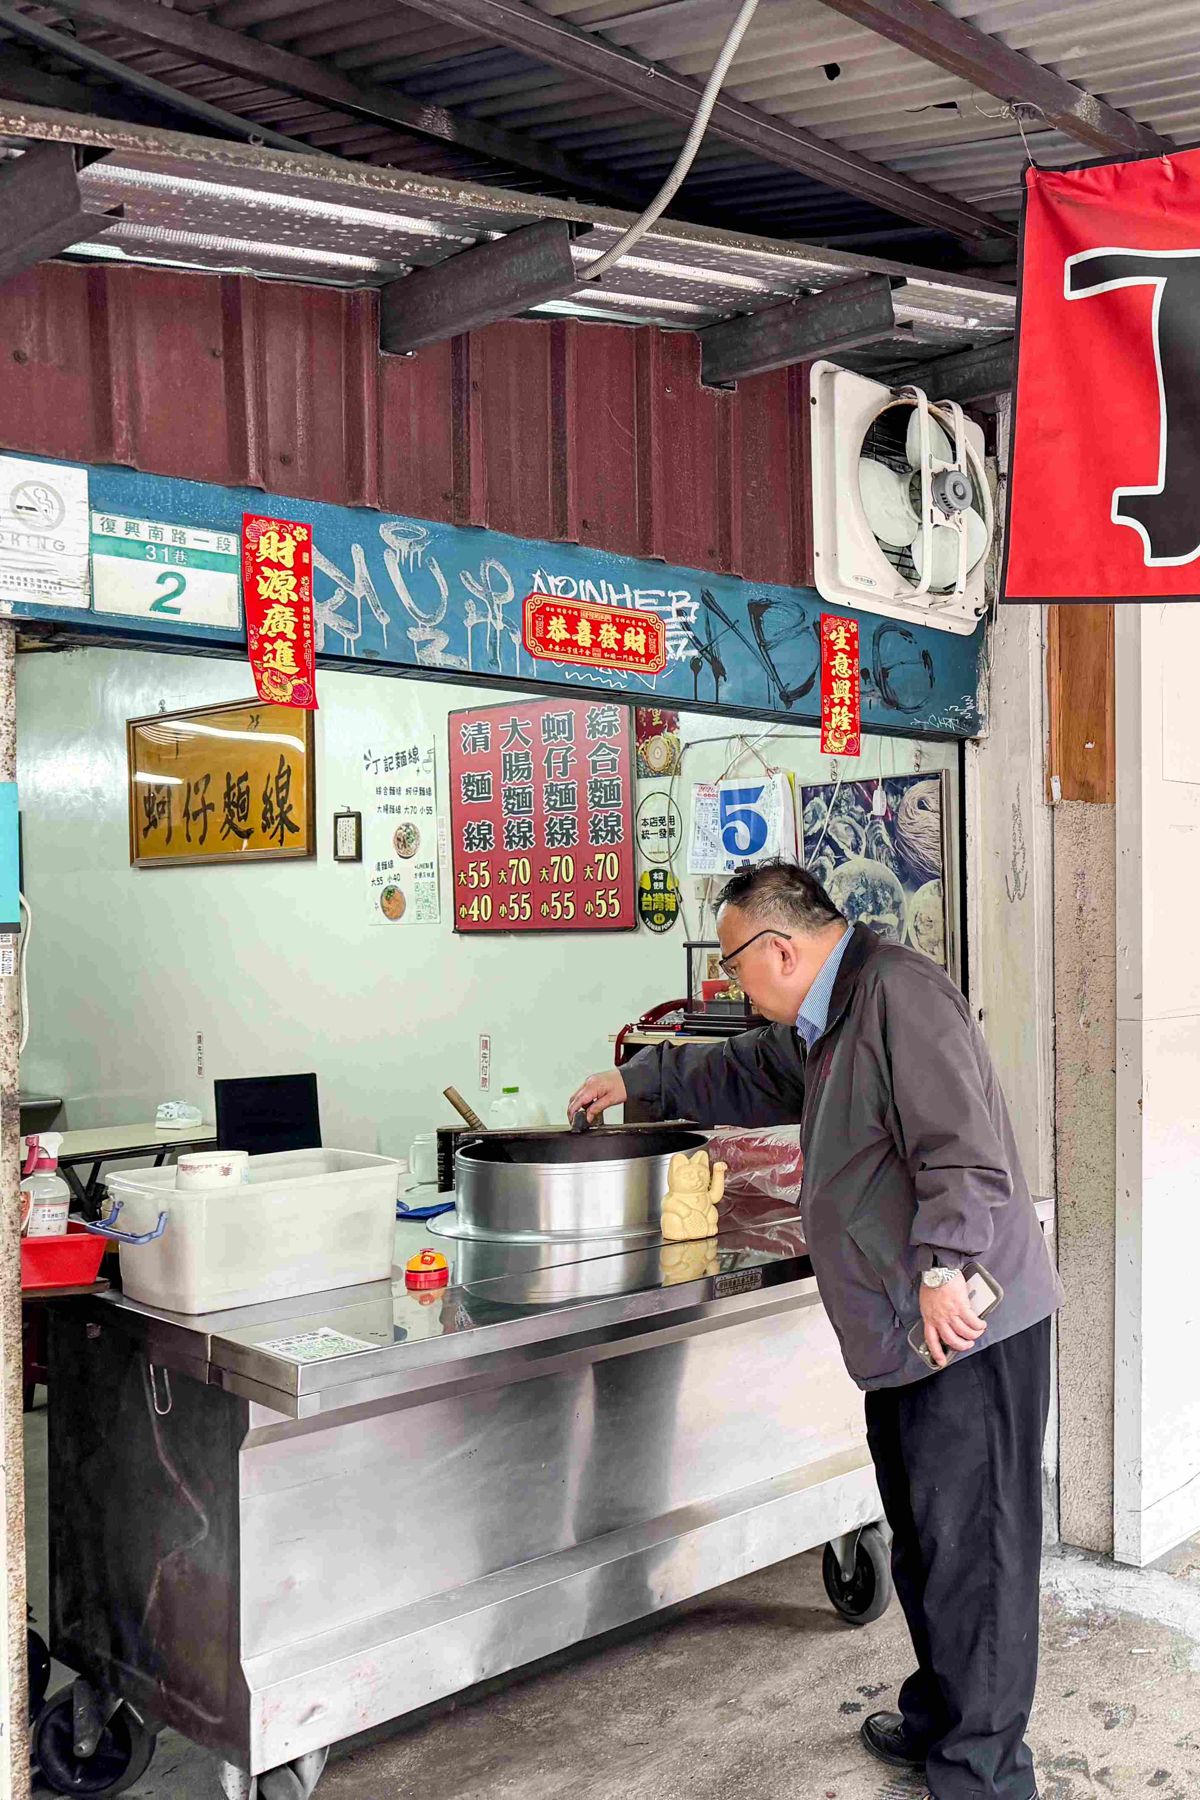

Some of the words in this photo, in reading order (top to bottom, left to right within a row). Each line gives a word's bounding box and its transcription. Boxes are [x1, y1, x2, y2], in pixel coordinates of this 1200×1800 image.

[100, 517, 232, 553] 復興南路一段
[145, 544, 188, 565] 31巷
[150, 571, 187, 615] 2
[256, 530, 300, 675] 財源廣進
[546, 614, 647, 655] 恭喜發財
[829, 626, 854, 731] 生意興隆
[371, 745, 420, 775] 丁記麵線
[585, 704, 624, 846] 綜合麵線
[461, 721, 494, 853] 清麵線
[499, 716, 536, 852] 大腸麵線
[541, 710, 578, 849] 蚵仔麵線
[143, 754, 300, 846] 蚵仔麵線
[720, 784, 768, 856] 5
[458, 860, 491, 889] 大55
[498, 857, 532, 886] 大70
[540, 855, 574, 884] 大70
[584, 851, 620, 881] 大70
[459, 894, 492, 920] 小40
[499, 892, 532, 921] 小55
[540, 890, 576, 920] 小55
[585, 887, 621, 918] 小55
[641, 892, 676, 911] 台灣豬
